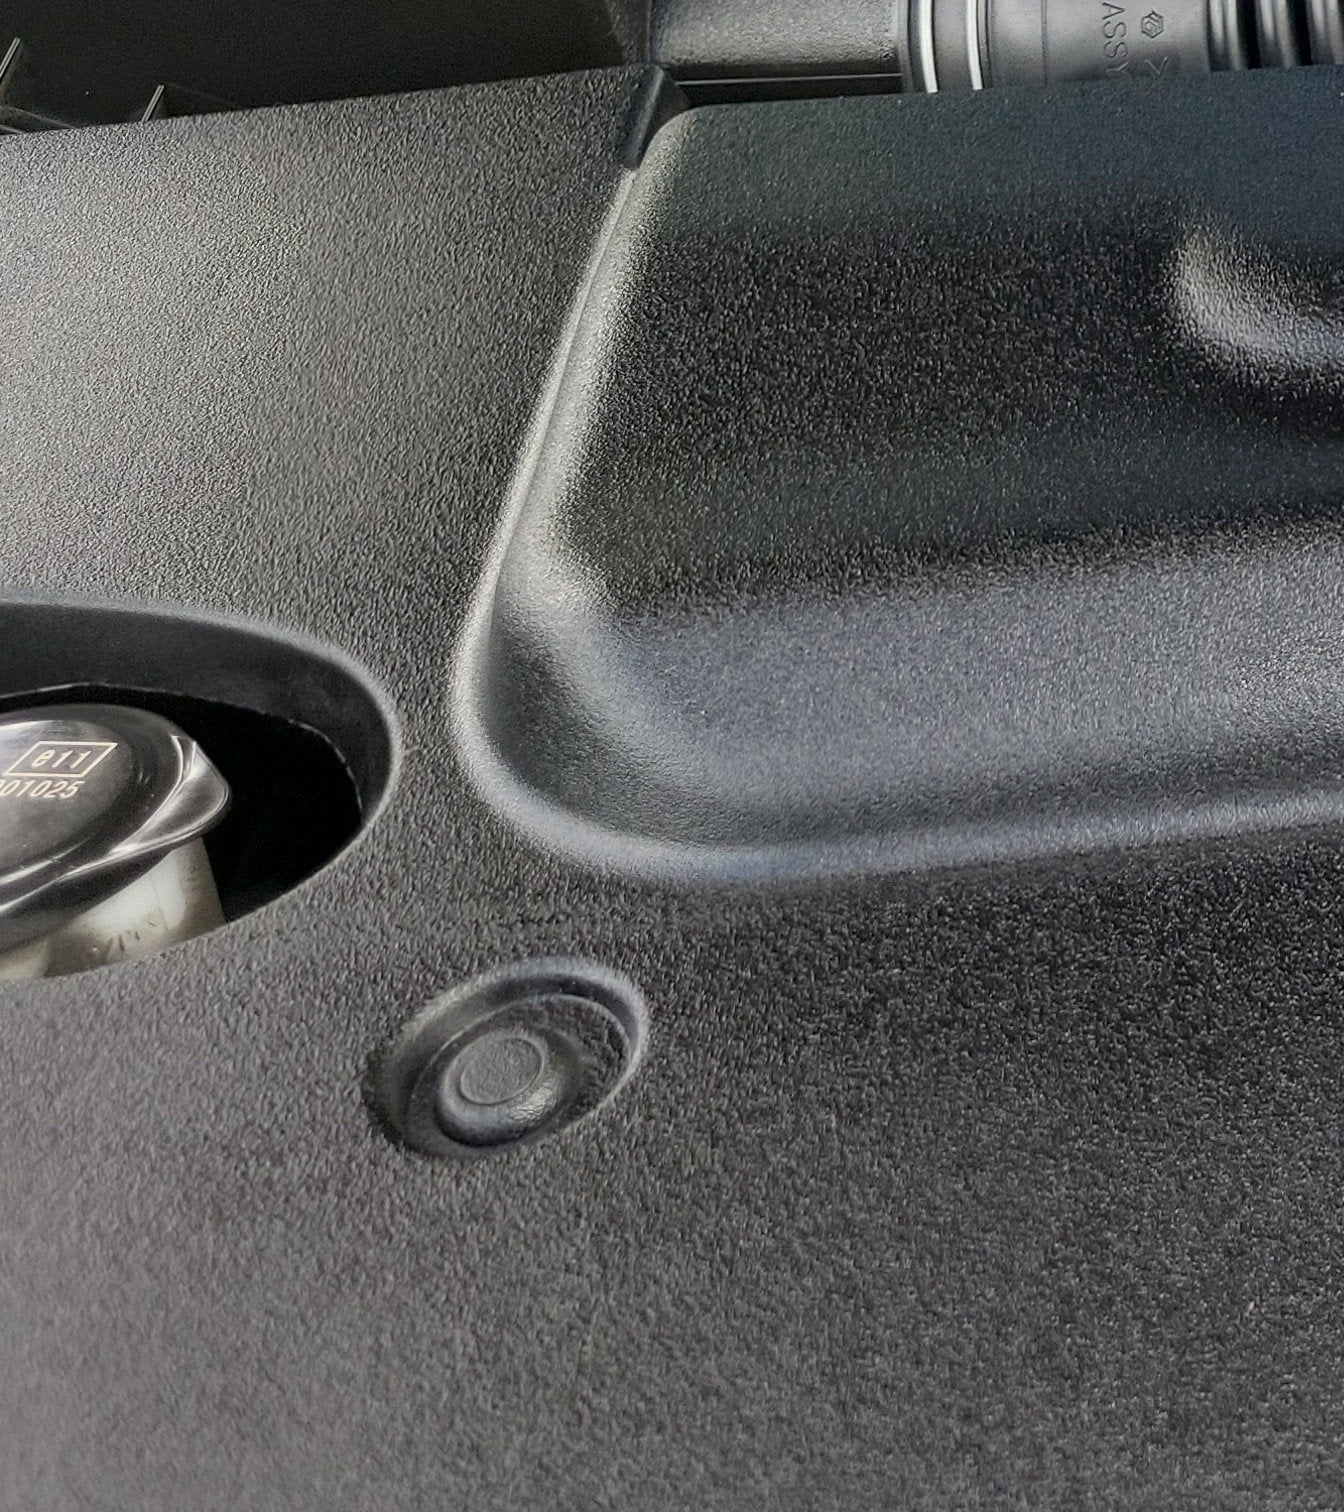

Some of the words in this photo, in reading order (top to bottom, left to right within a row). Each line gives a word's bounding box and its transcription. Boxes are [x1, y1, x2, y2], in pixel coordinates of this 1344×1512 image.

[1102, 1, 1128, 79] ASSY
[31, 749, 92, 769] e11
[0, 779, 86, 798] 01025
